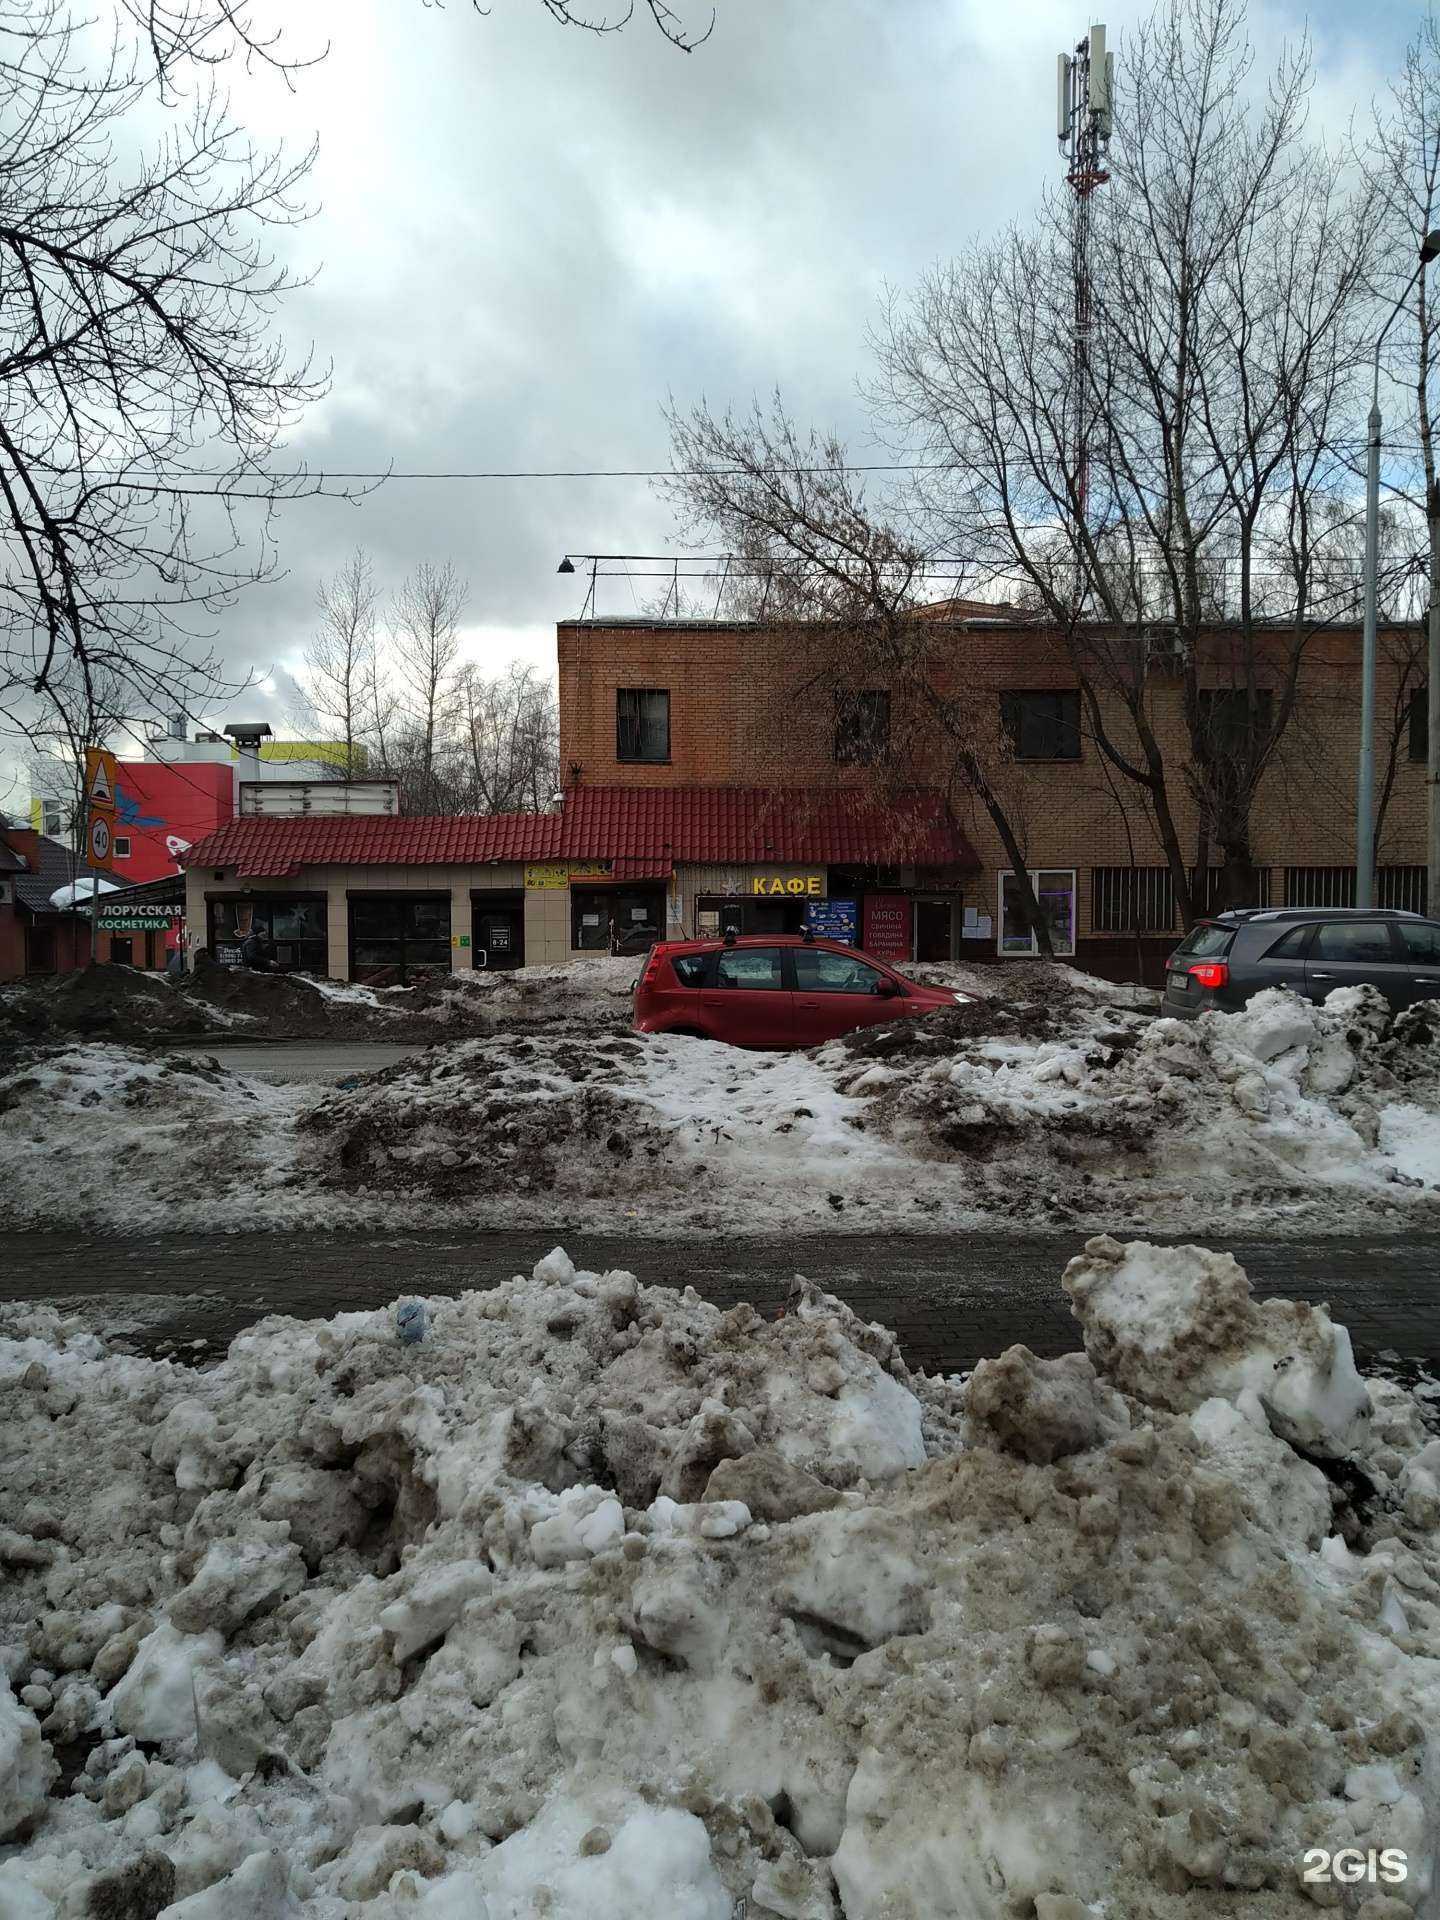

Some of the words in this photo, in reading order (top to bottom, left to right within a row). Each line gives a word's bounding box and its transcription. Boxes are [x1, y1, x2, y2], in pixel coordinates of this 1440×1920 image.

[94, 831, 107, 849] 40
[753, 877, 822, 895] КАФЕ
[86, 904, 182, 916] БЛОРУССКАЯ
[871, 910, 904, 921] МЯСО
[97, 919, 169, 929] КОСМЕТИКА
